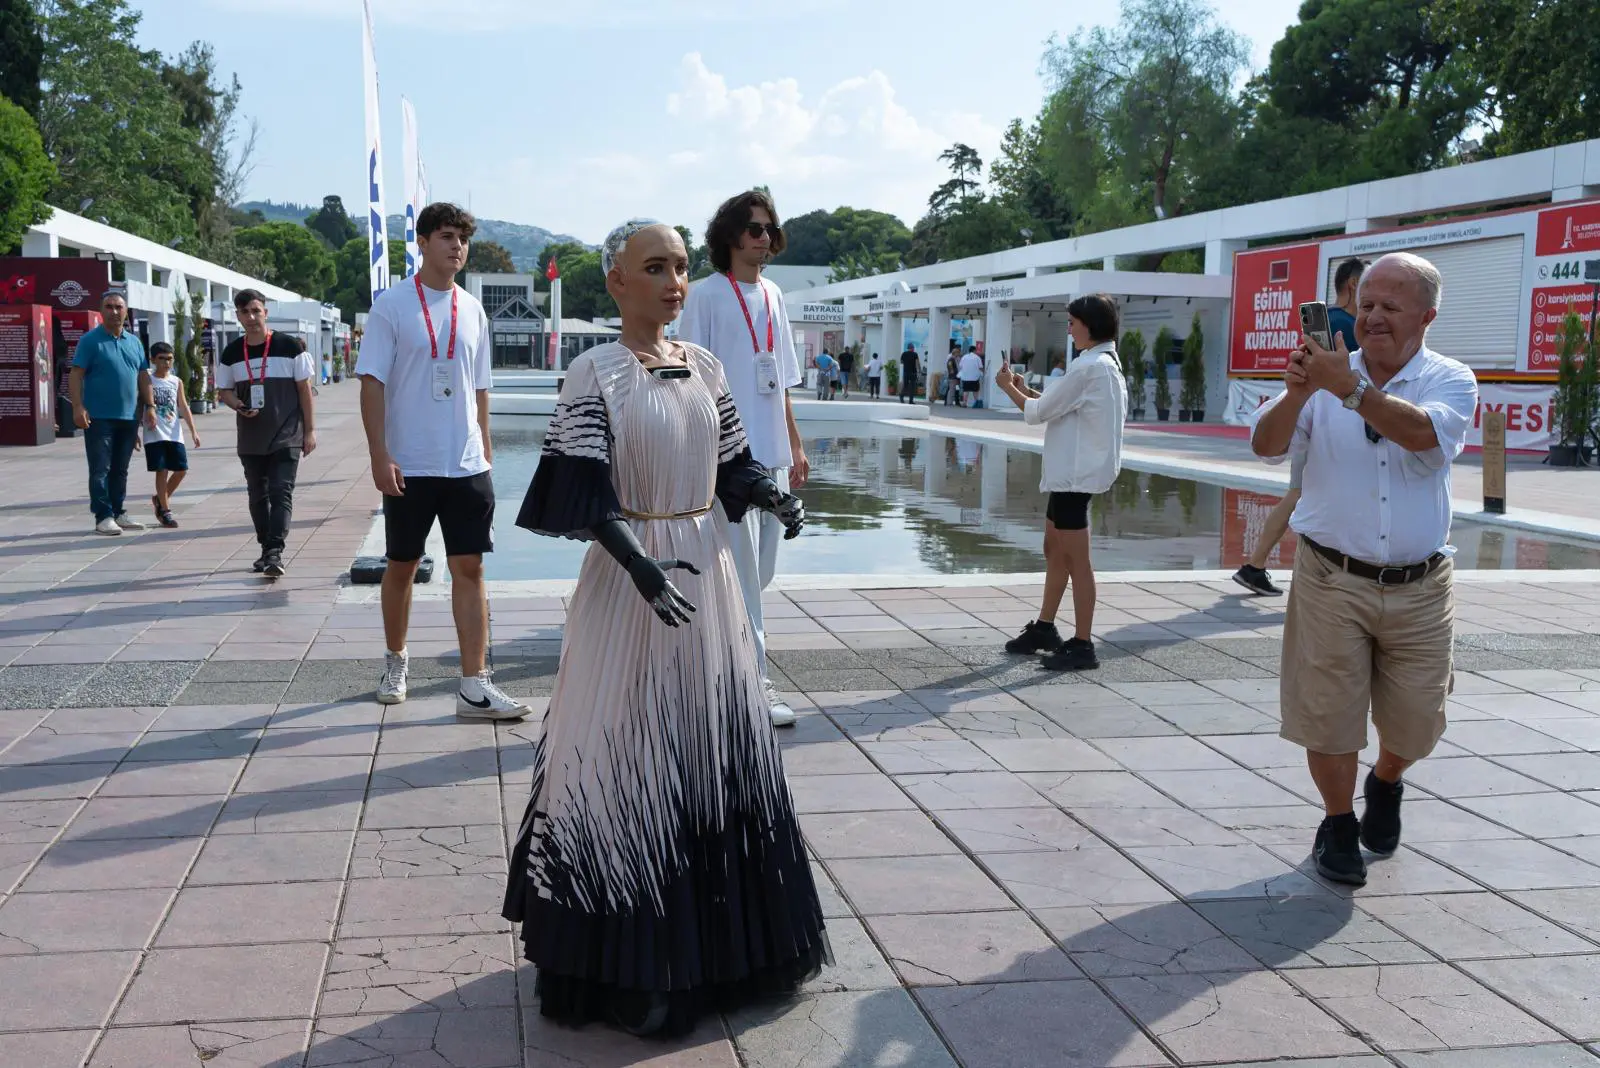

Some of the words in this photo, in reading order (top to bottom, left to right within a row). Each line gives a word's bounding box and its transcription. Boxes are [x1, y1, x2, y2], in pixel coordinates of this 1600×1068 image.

[1552, 260, 1580, 280] 444
[966, 289, 989, 301] Bornova
[1254, 286, 1293, 311] EĞİTİM
[803, 305, 844, 313] BAYRAKLI
[1255, 311, 1290, 330] HAYAT
[1245, 331, 1299, 350] KURTARIR
